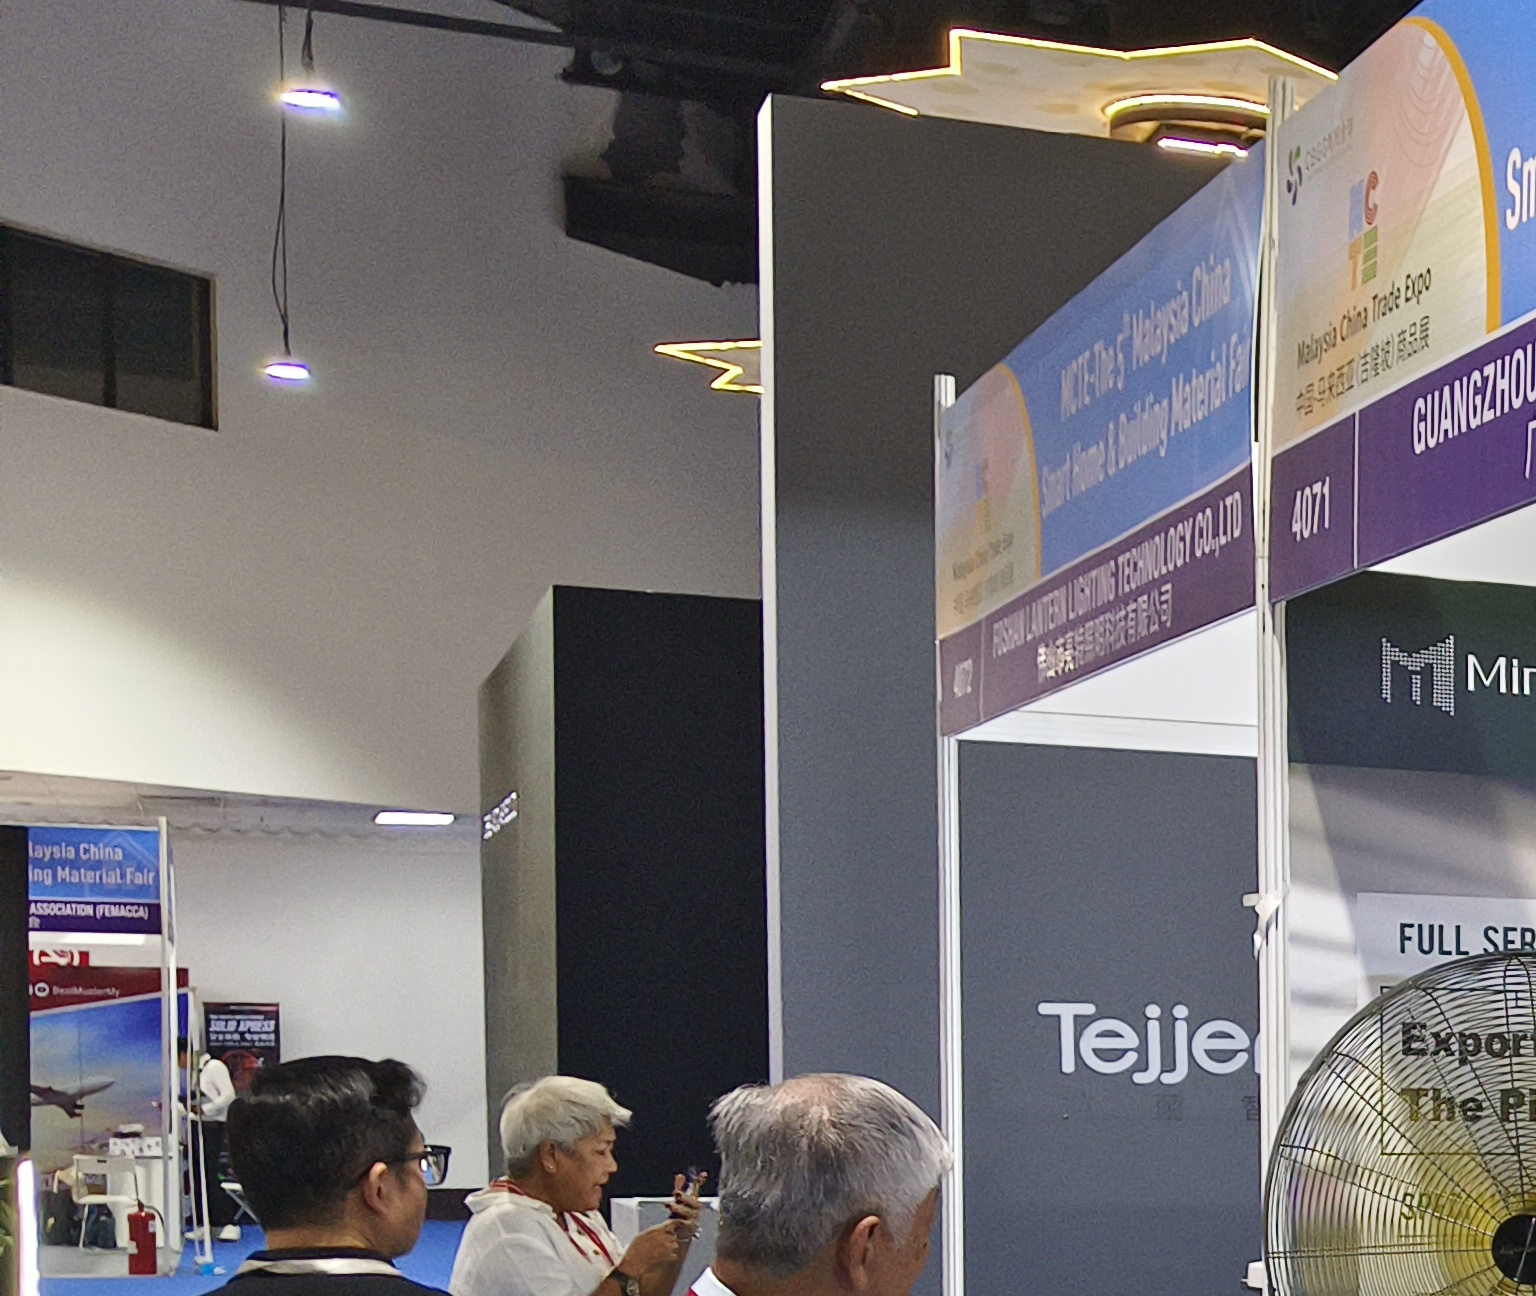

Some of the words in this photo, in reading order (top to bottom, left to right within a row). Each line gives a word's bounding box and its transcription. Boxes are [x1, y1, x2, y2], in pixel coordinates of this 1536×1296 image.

[1132, 279, 1189, 372] Malaysia
[1192, 253, 1232, 328] China
[1297, 322, 1337, 369] Malaysia
[1340, 301, 1369, 342] China
[1371, 280, 1401, 324] Trade
[1405, 267, 1432, 306] Expo
[1170, 342, 1227, 437] Material
[1229, 325, 1251, 399] Fai
[1291, 475, 1332, 541] 4071
[1118, 516, 1195, 596] TECHNOLOGY
[57, 867, 123, 886] Material
[126, 867, 156, 887] Fair
[79, 843, 124, 862] China
[1400, 923, 1470, 956] FULL
[1037, 1001, 1261, 1084] Tejje
[1401, 1087, 1484, 1124] The
